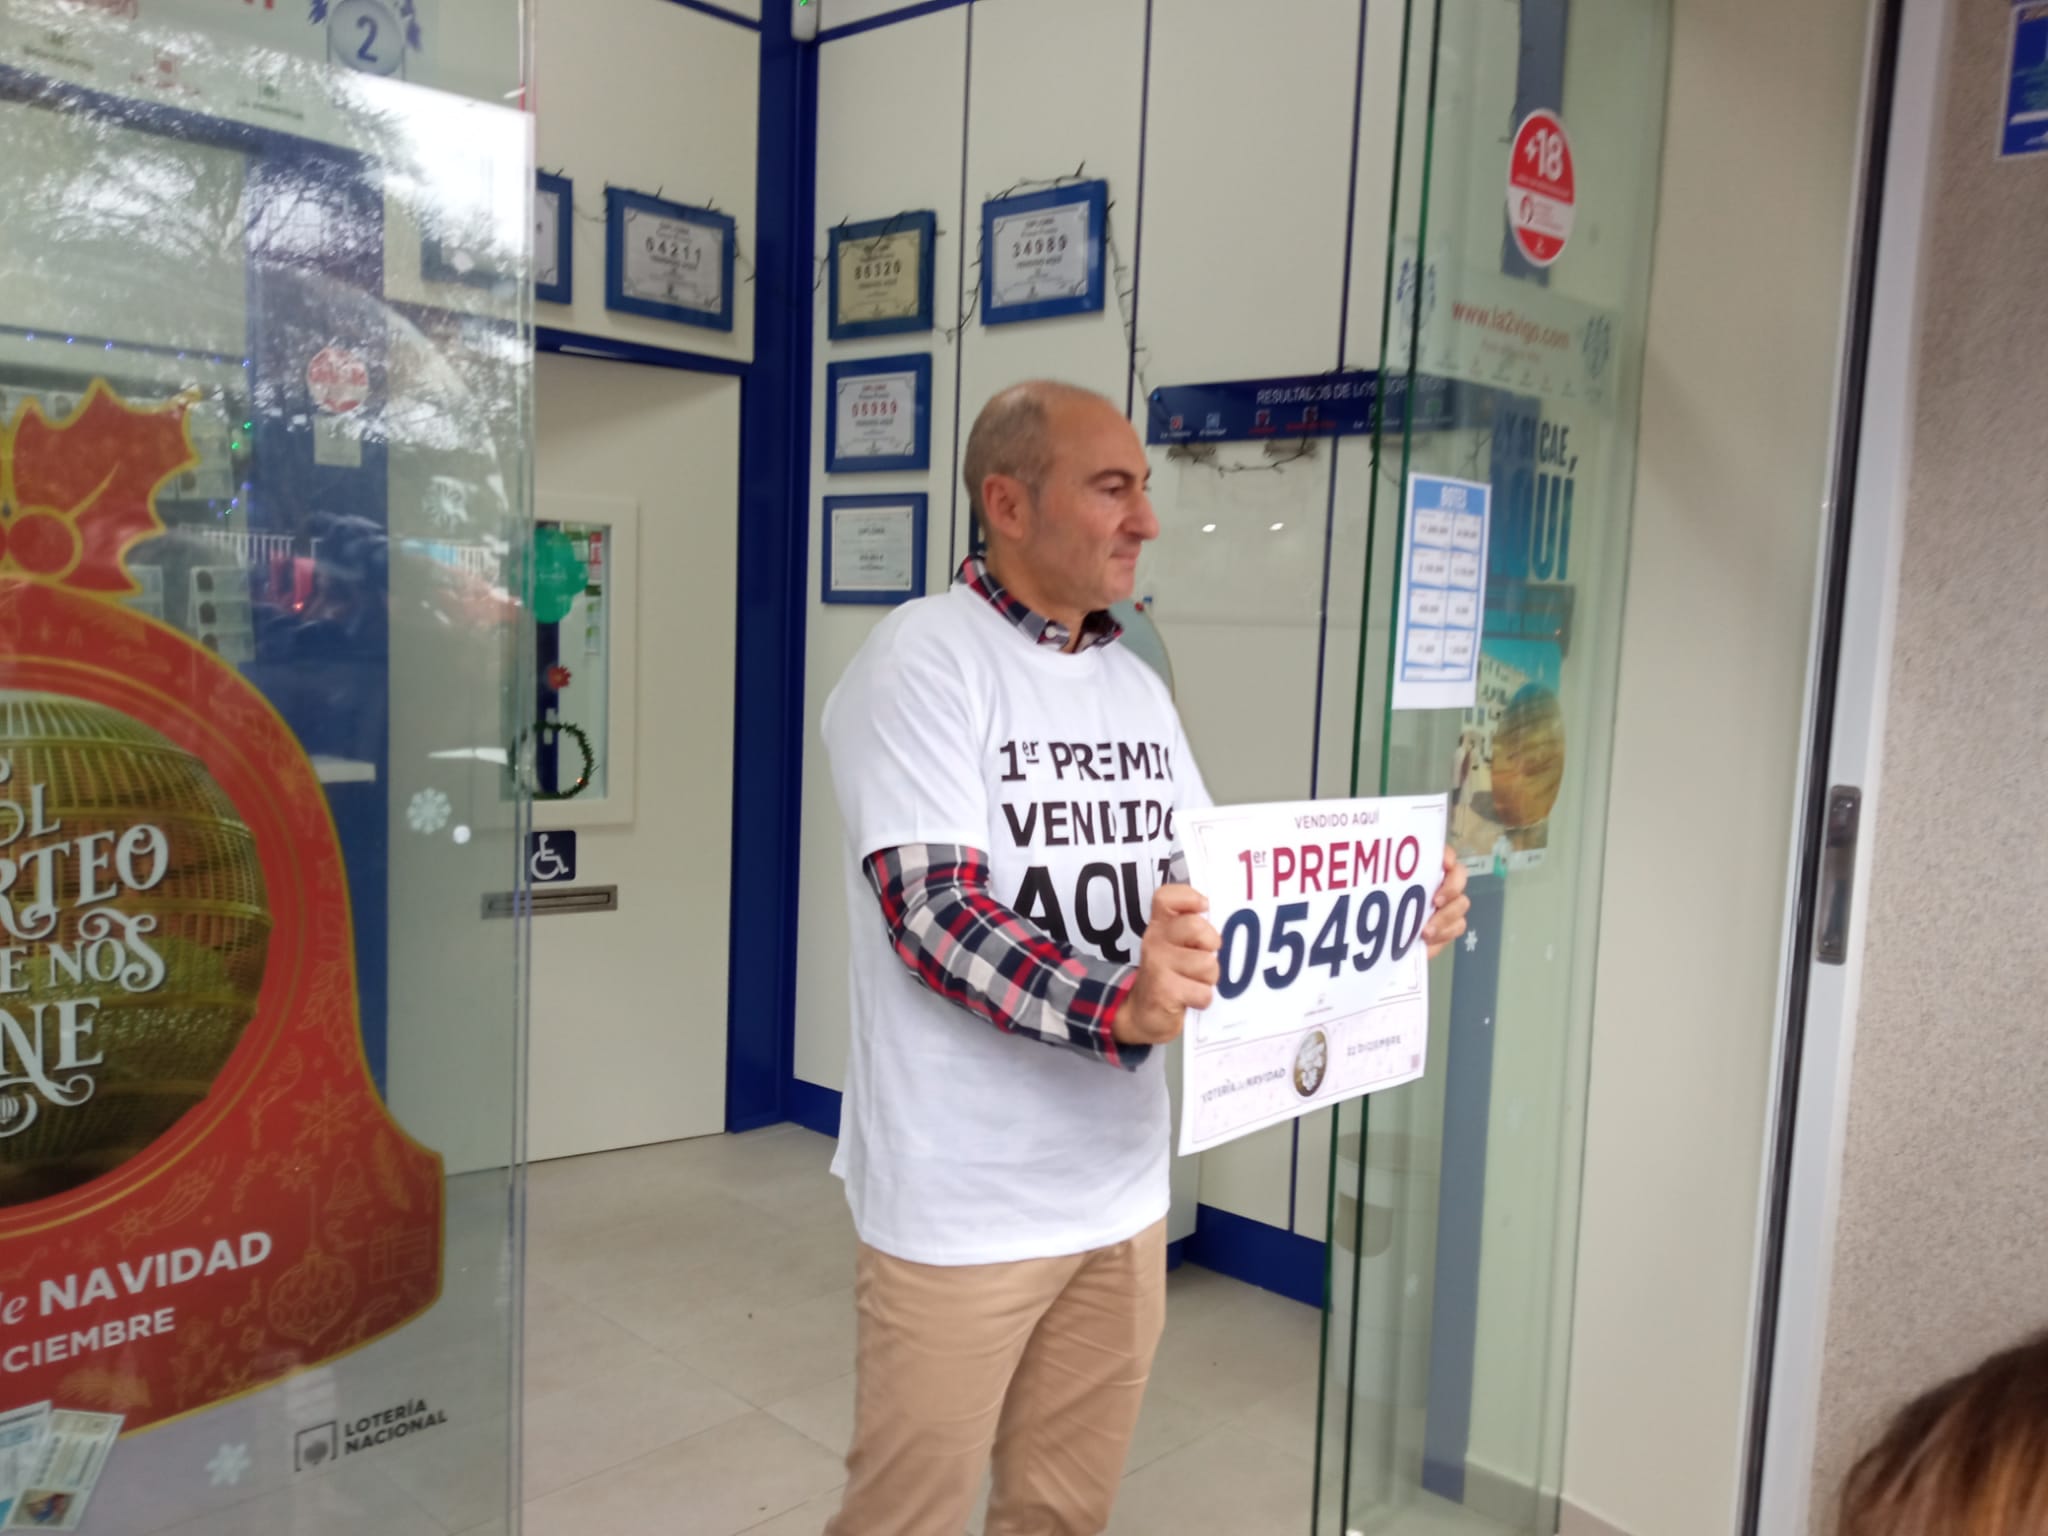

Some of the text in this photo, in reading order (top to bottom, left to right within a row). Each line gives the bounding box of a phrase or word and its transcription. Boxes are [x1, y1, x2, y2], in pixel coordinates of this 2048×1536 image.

[356, 15, 378, 63] 2
[1524, 128, 1563, 181] +18
[1295, 807, 1380, 830] VENDIDO AQUÍ
[1273, 834, 1420, 897] PREMIO
[1215, 884, 1427, 1000] 05490
[39, 1231, 272, 1316] NAVIDAD
[344, 1398, 427, 1438] LOTERÍA
[344, 1410, 448, 1455] NACIONAL
